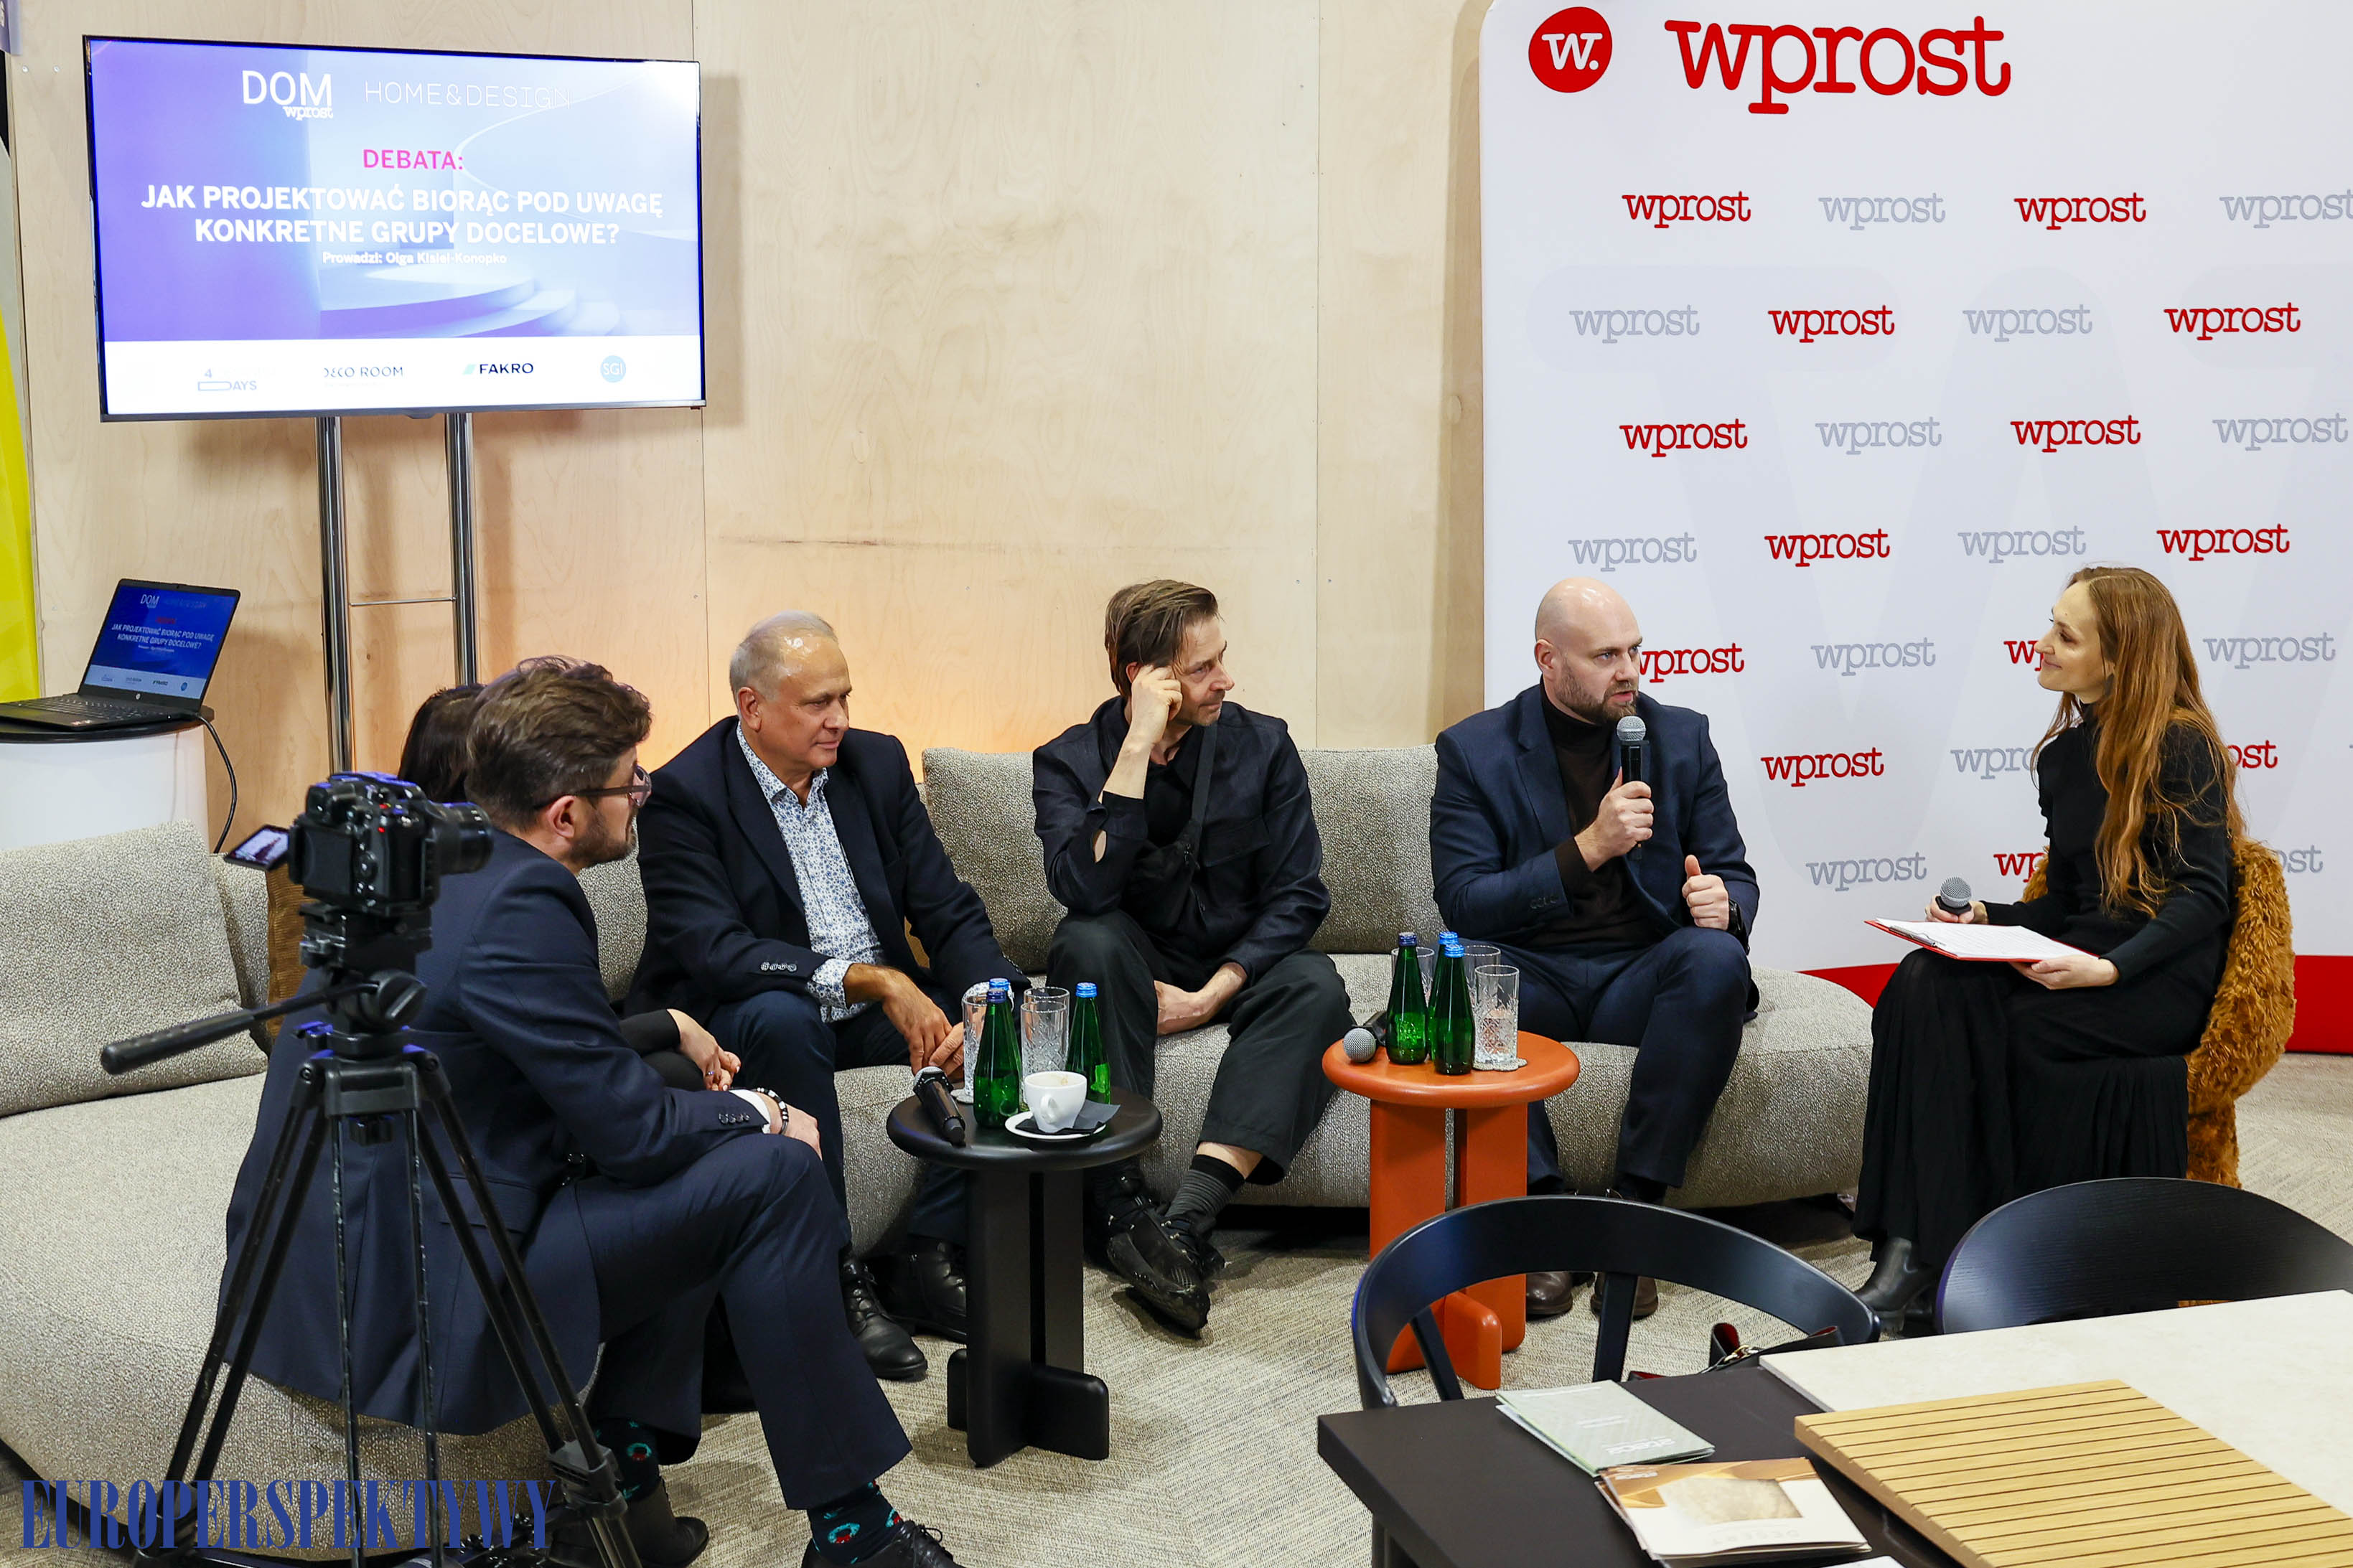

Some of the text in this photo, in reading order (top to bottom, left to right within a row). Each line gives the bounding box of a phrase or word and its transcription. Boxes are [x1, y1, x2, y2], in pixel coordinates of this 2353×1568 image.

[1542, 32, 1603, 71] w.
[1665, 16, 2011, 115] wprost
[242, 69, 333, 106] DOM
[364, 79, 571, 109] HOME&DESIGN
[283, 104, 334, 121] wprost
[362, 149, 463, 170] DEBATA:
[141, 183, 663, 218] JAK PROJEKTOWAĆ BIORĄC POD UWAGĘ
[1622, 192, 1751, 228] wprost
[1818, 192, 1946, 230] wprost
[2014, 193, 2146, 230] wprost
[195, 218, 620, 245] KONKRETNE GRUPY DOCELOWE?
[322, 251, 383, 265] Prowadzi:
[385, 251, 414, 266] Olga
[1569, 304, 1700, 344] wprost
[1769, 306, 1894, 342] wprost
[1963, 304, 2092, 342] wprost
[2165, 303, 2301, 340] wprost
[360, 366, 404, 377] ROOM
[479, 362, 534, 375] FAKRO
[1620, 419, 1747, 457] wprost
[1815, 416, 1942, 455] wprost
[2011, 416, 2141, 452] wprost
[2212, 413, 2349, 451] wprost
[1568, 532, 1697, 572] wprost
[1765, 529, 1889, 567] wprost
[1957, 525, 2085, 563] wprost
[2157, 524, 2290, 561] wprost
[141, 594, 160, 604] DOM
[1811, 637, 1936, 676] wprost
[2202, 632, 2336, 670] wprost
[1762, 748, 1884, 787] wprost
[1950, 747, 2036, 780] wpro
[2227, 740, 2278, 769] ost
[1805, 852, 1928, 891] wprost
